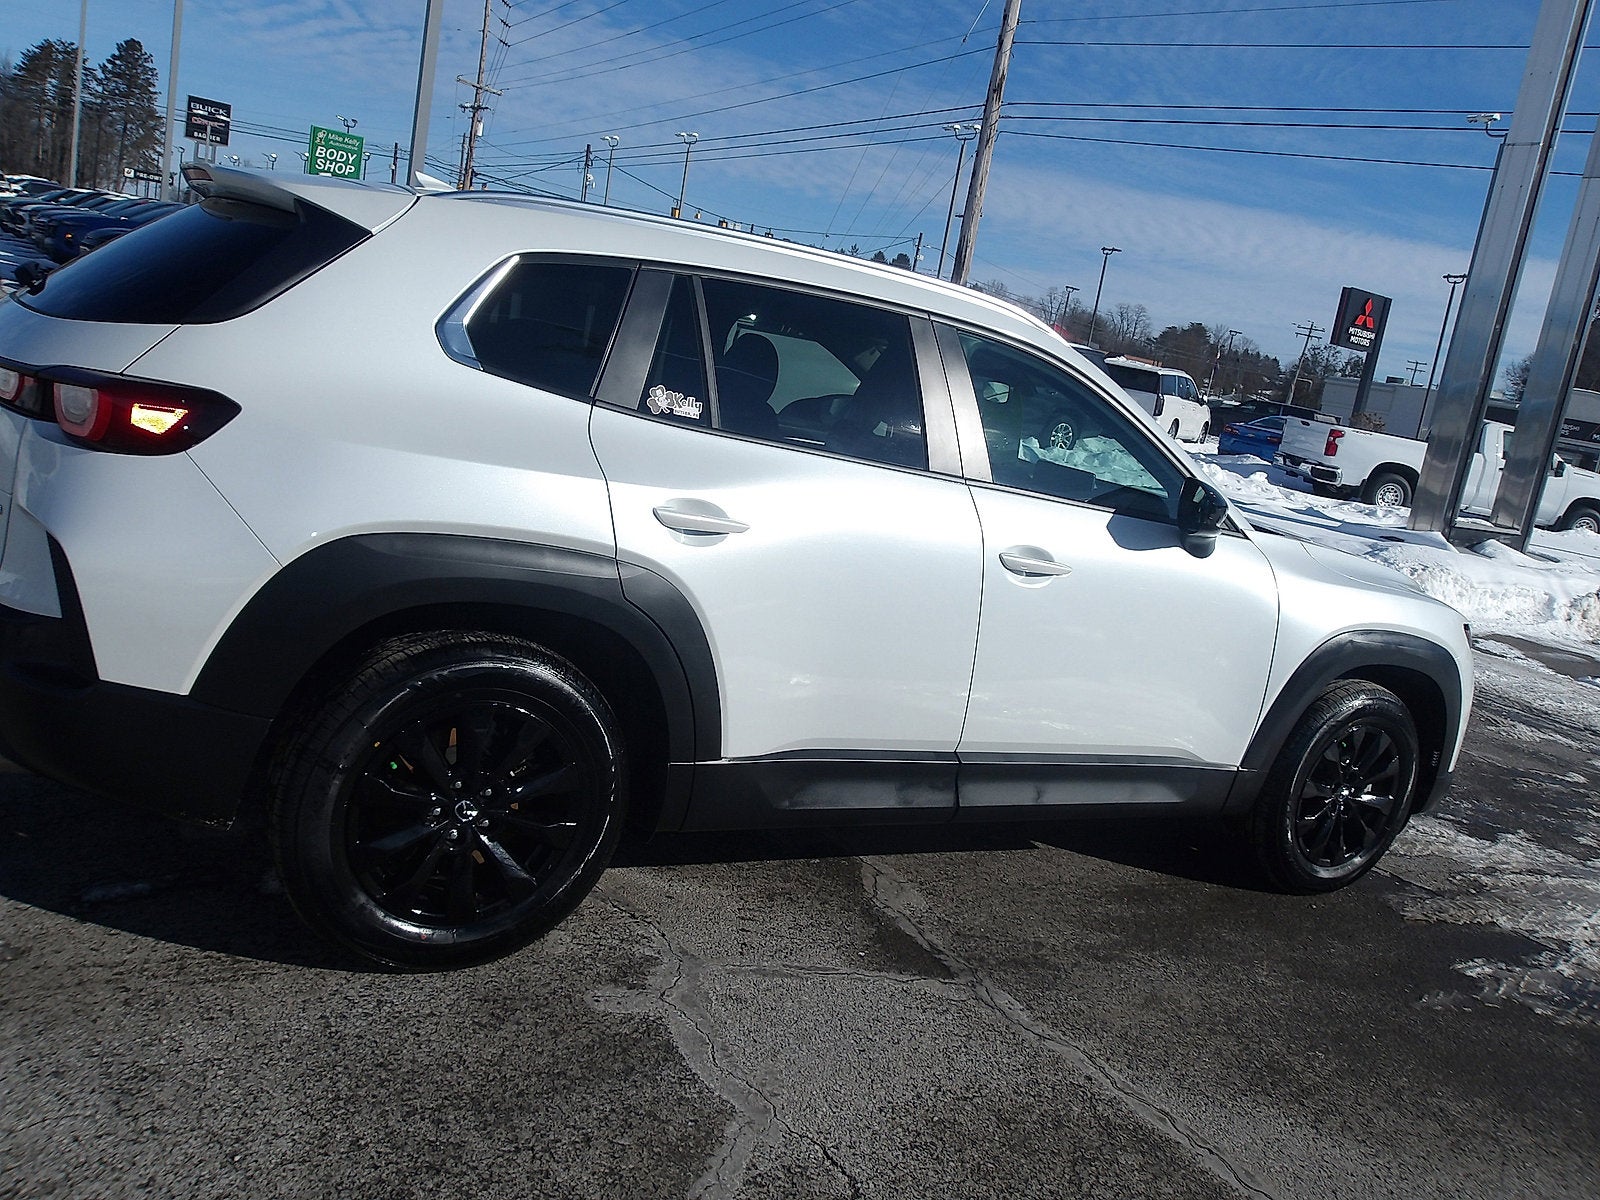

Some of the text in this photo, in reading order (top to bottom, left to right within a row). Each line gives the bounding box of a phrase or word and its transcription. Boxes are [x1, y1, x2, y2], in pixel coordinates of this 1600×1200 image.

[190, 102, 228, 116] BUICK
[193, 132, 220, 141] BAGIER
[328, 133, 360, 147] Mike Kelly
[315, 146, 357, 164] BODY
[315, 158, 355, 175] SHOP
[1348, 327, 1376, 340] MITSUBISHI
[1350, 335, 1370, 346] MOTORS
[673, 393, 702, 414] Kelly
